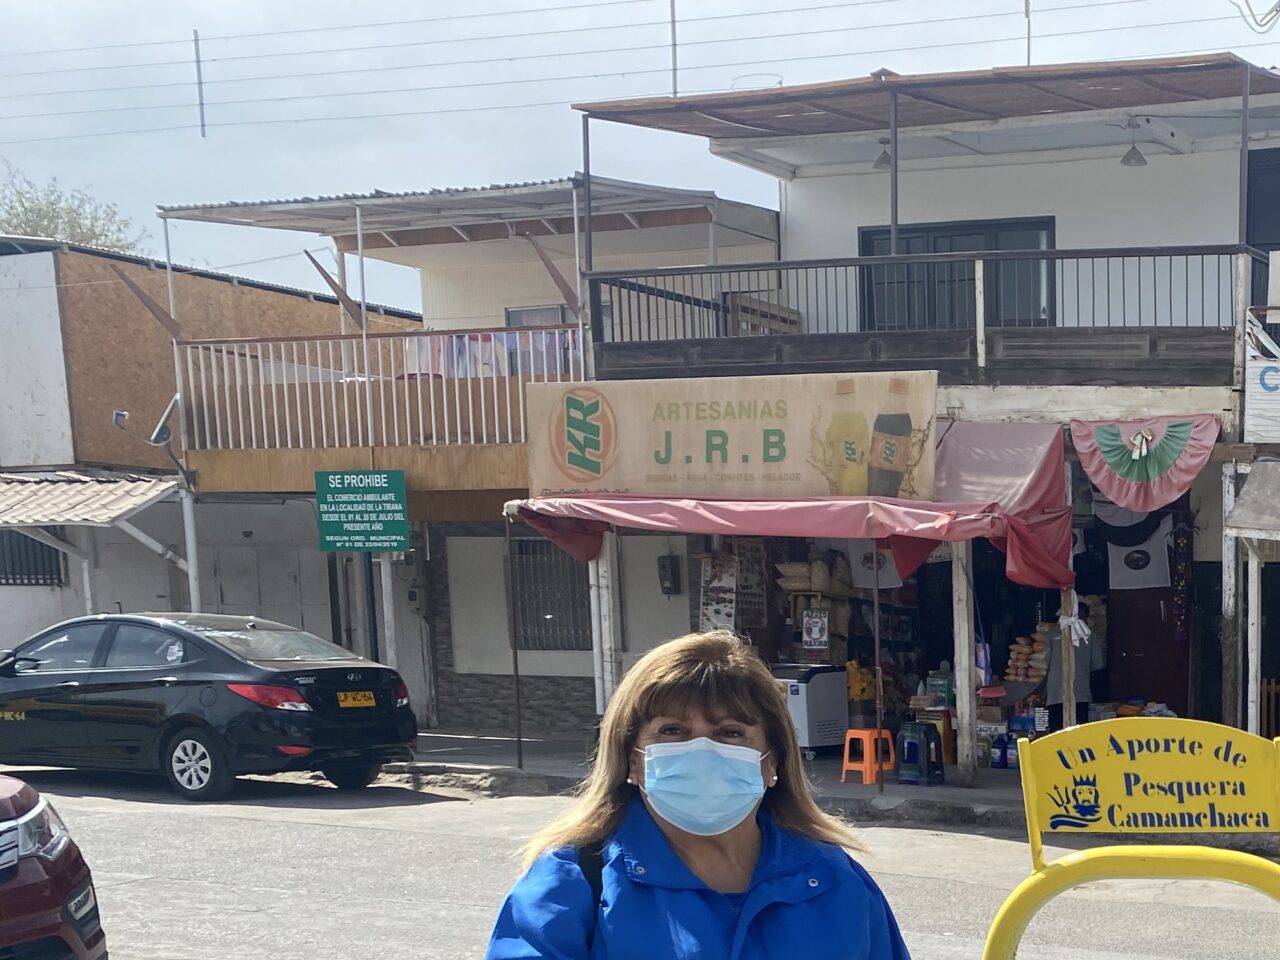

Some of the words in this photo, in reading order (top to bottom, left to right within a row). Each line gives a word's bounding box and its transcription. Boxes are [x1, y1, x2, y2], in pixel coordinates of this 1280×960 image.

[652, 400, 788, 421] ARTESANIAS
[566, 394, 602, 475] KR
[328, 475, 342, 488] SE
[344, 474, 388, 487] PROHIBE
[762, 473, 800, 481] HELADOS
[335, 493, 363, 501] COMERCIO
[363, 493, 395, 501] AMBULANTE
[336, 503, 366, 511] LOCALIDAD
[375, 503, 382, 511] LA
[394, 512, 405, 520] DEL
[343, 523, 371, 531] PRESENTE
[371, 521, 383, 531] AÑO
[1056, 746, 1096, 770] Un
[1106, 733, 1204, 762] Aporte
[1213, 740, 1248, 769] de
[1123, 771, 1247, 804] Pesquera
[1107, 802, 1270, 829] Camanchaca
